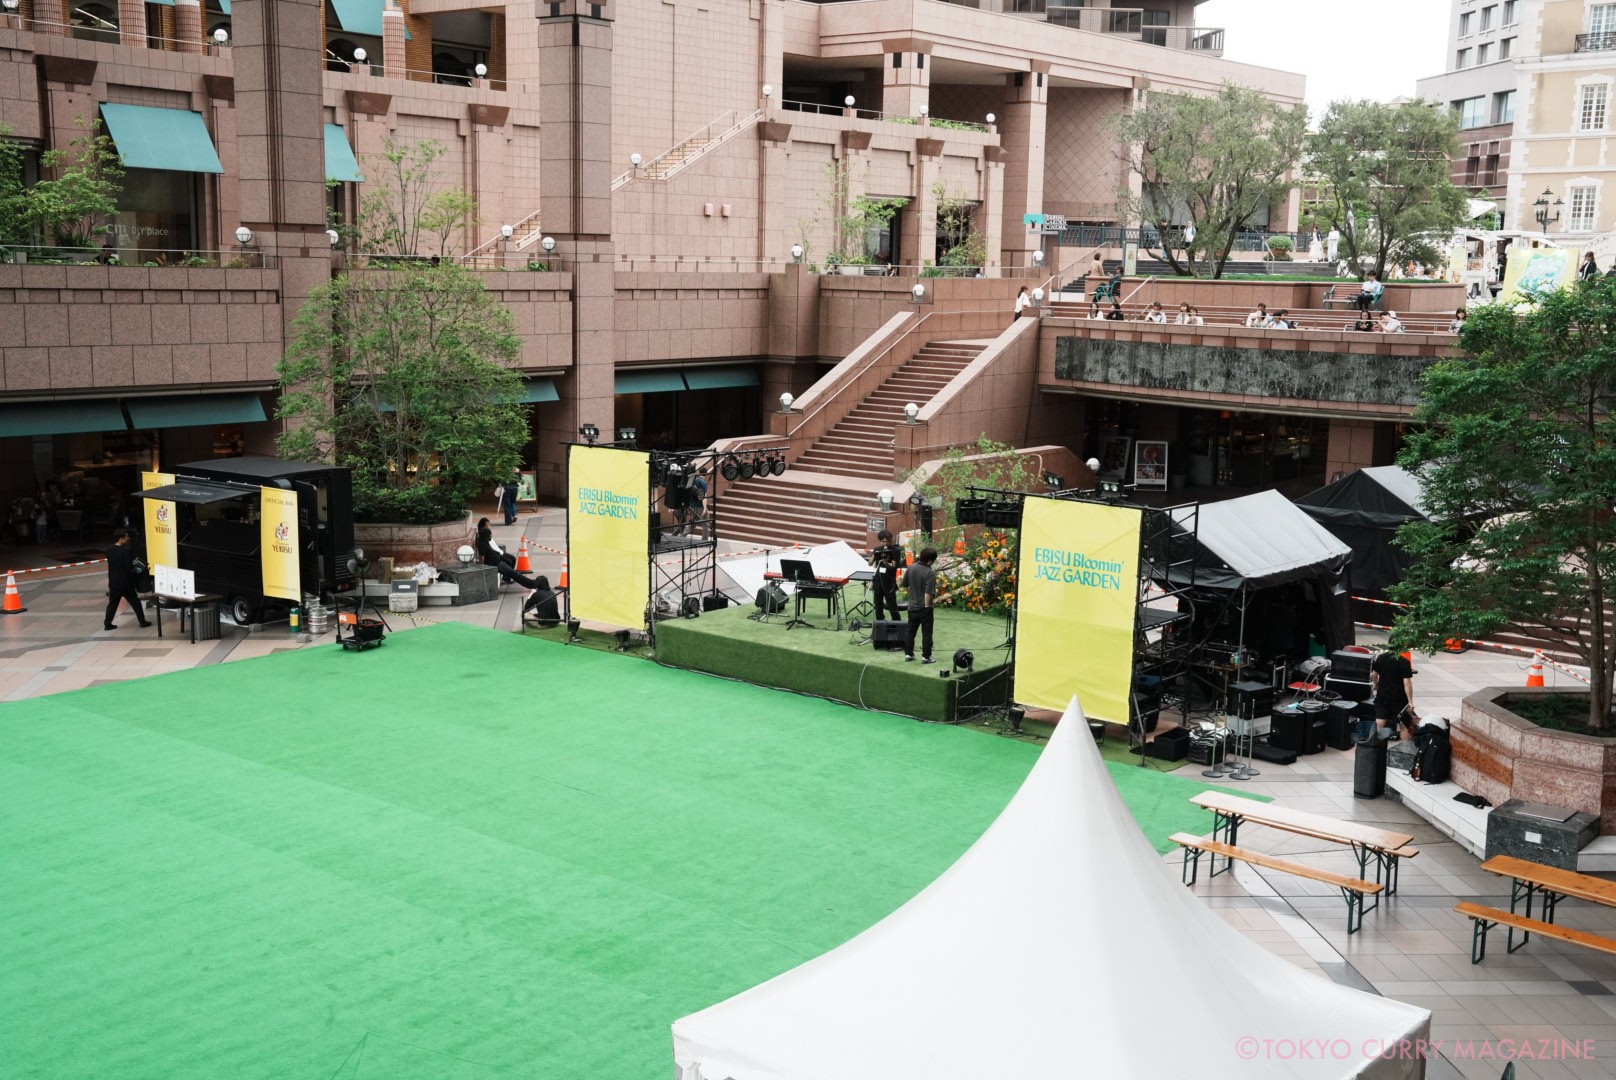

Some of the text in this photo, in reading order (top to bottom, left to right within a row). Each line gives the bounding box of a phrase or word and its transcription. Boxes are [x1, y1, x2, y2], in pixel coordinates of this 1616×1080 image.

[578, 487, 640, 506] EBISU Bloomin'
[579, 501, 637, 520] JAZZ GARDEN
[272, 544, 293, 555] YEBISU
[1035, 547, 1125, 574] EBISU Bloomin'
[1034, 564, 1120, 591] JAZZ GARDEN
